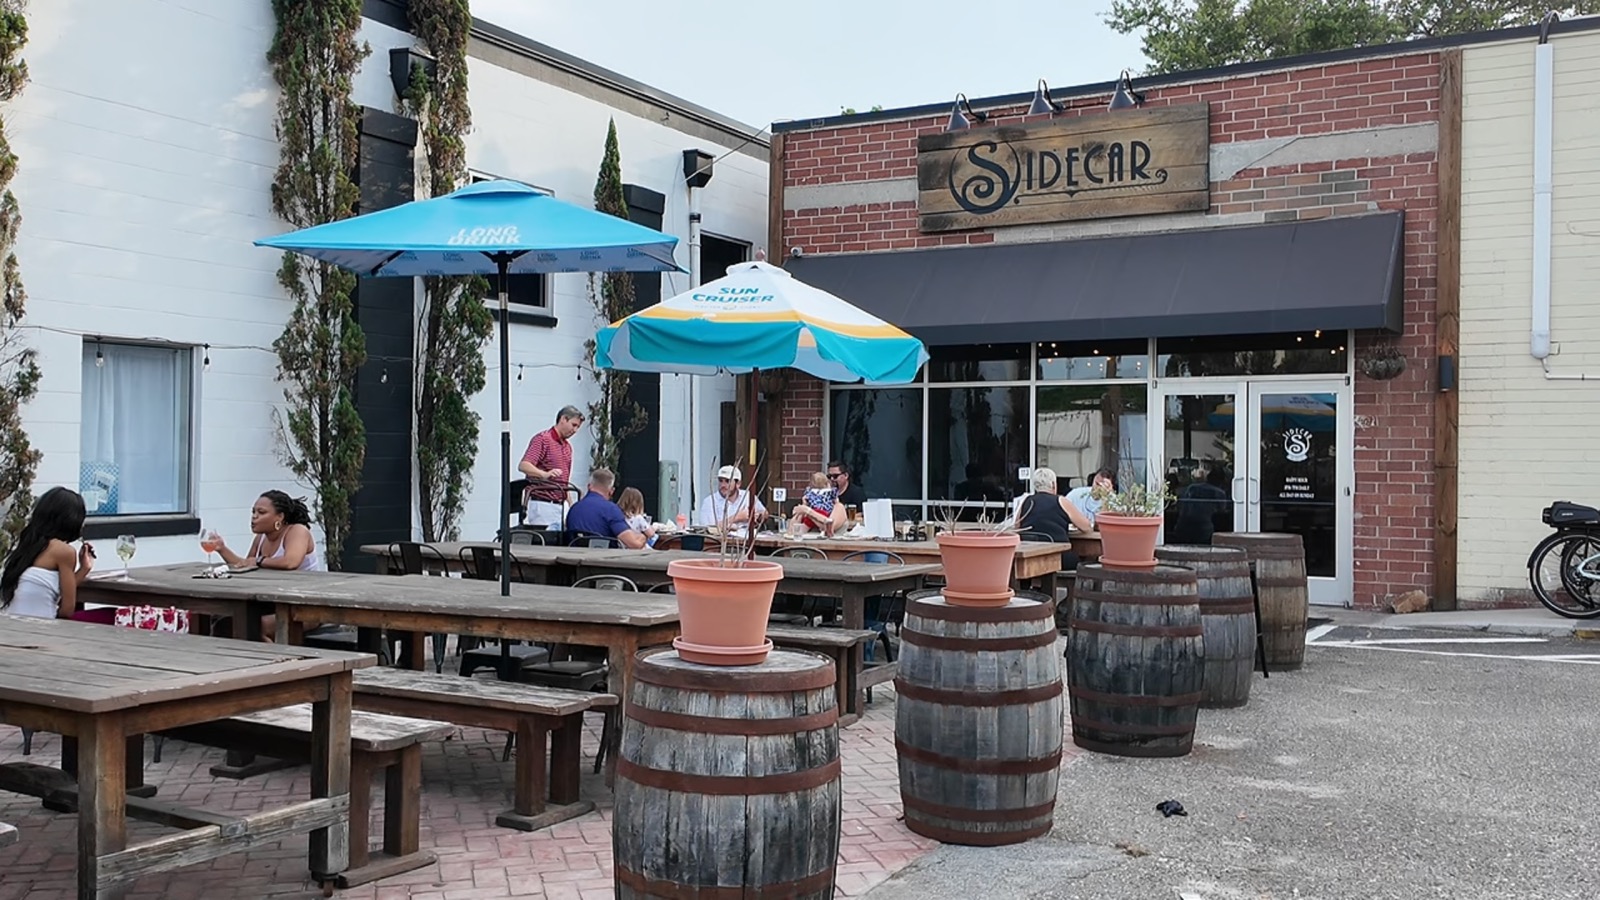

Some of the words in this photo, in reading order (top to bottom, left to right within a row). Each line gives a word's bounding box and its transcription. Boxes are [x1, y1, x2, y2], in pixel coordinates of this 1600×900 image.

[950, 140, 1151, 214] SIDECAR
[457, 226, 517, 237] LONG
[448, 234, 520, 245] DRINK
[719, 287, 759, 295] SUN
[692, 293, 774, 303] CRUISER
